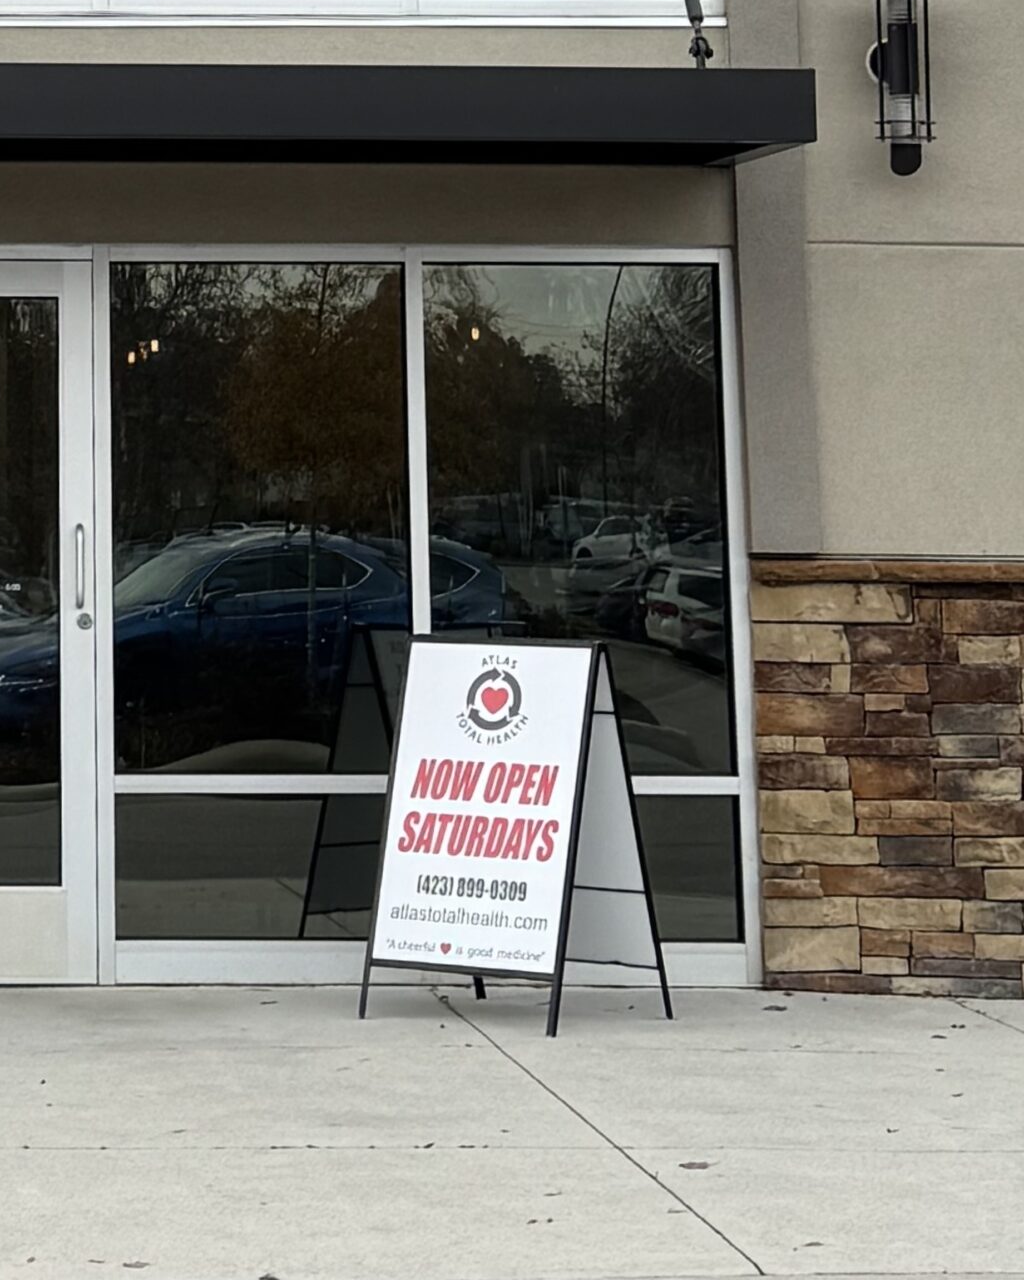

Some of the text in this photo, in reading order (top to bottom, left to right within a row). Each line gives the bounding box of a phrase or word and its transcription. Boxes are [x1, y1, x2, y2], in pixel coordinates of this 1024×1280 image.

[481, 654, 518, 670] ATLAS
[456, 712, 529, 747] TOTAL HEALTH
[410, 758, 560, 806] NOW OPEN
[397, 811, 559, 862] SATURDAYS
[416, 874, 528, 902] (423) 899-0309
[390, 903, 548, 932] atlastotalhealth.com
[398, 939, 436, 953] cheerful
[455, 946, 463, 955] is
[467, 946, 494, 959] good
